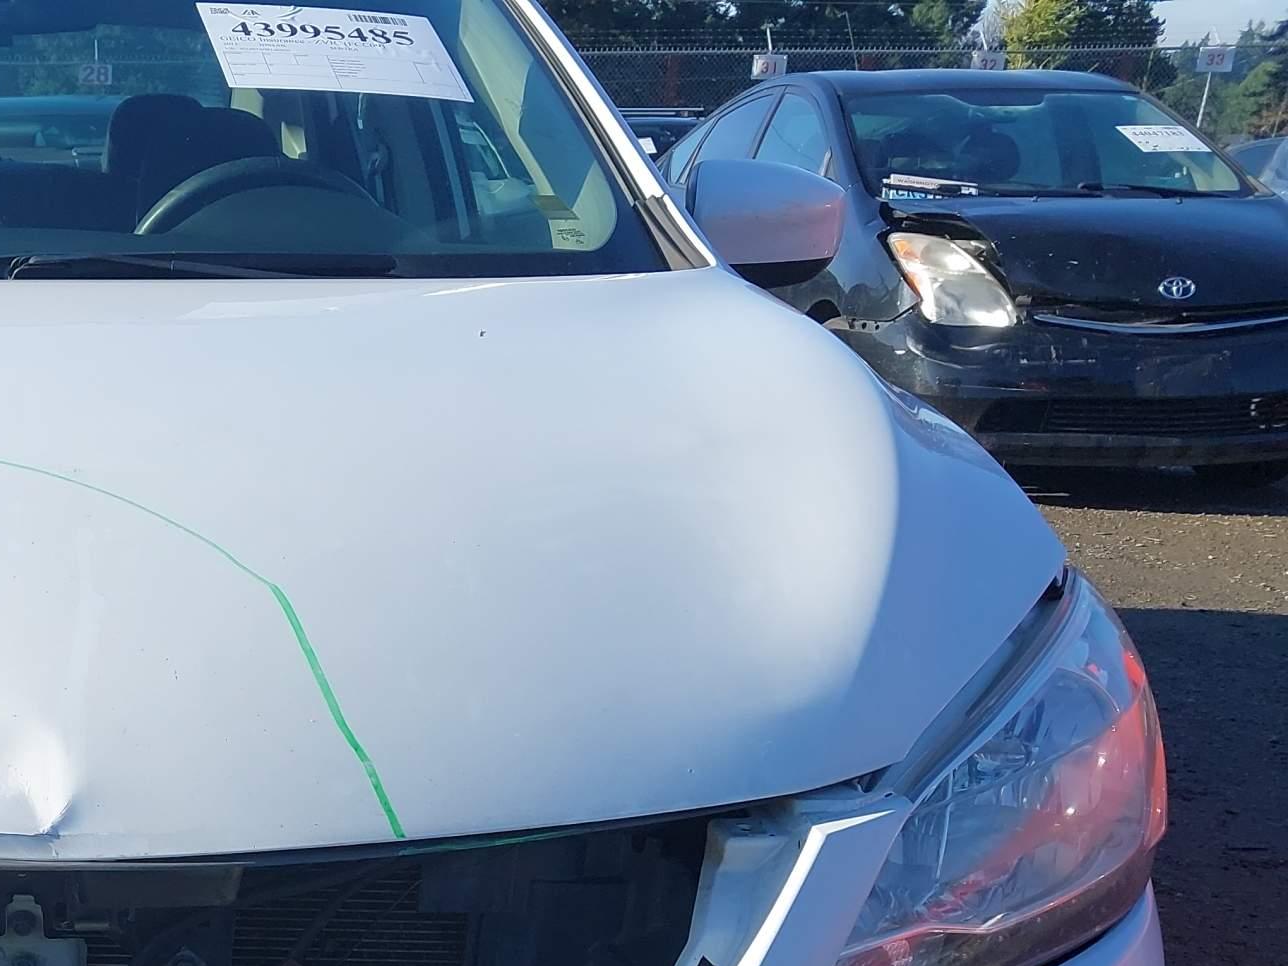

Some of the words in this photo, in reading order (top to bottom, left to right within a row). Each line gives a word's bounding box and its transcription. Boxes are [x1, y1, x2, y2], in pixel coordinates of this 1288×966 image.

[232, 21, 415, 46] 43995485
[1206, 54, 1225, 66] 33
[82, 66, 110, 83] 28
